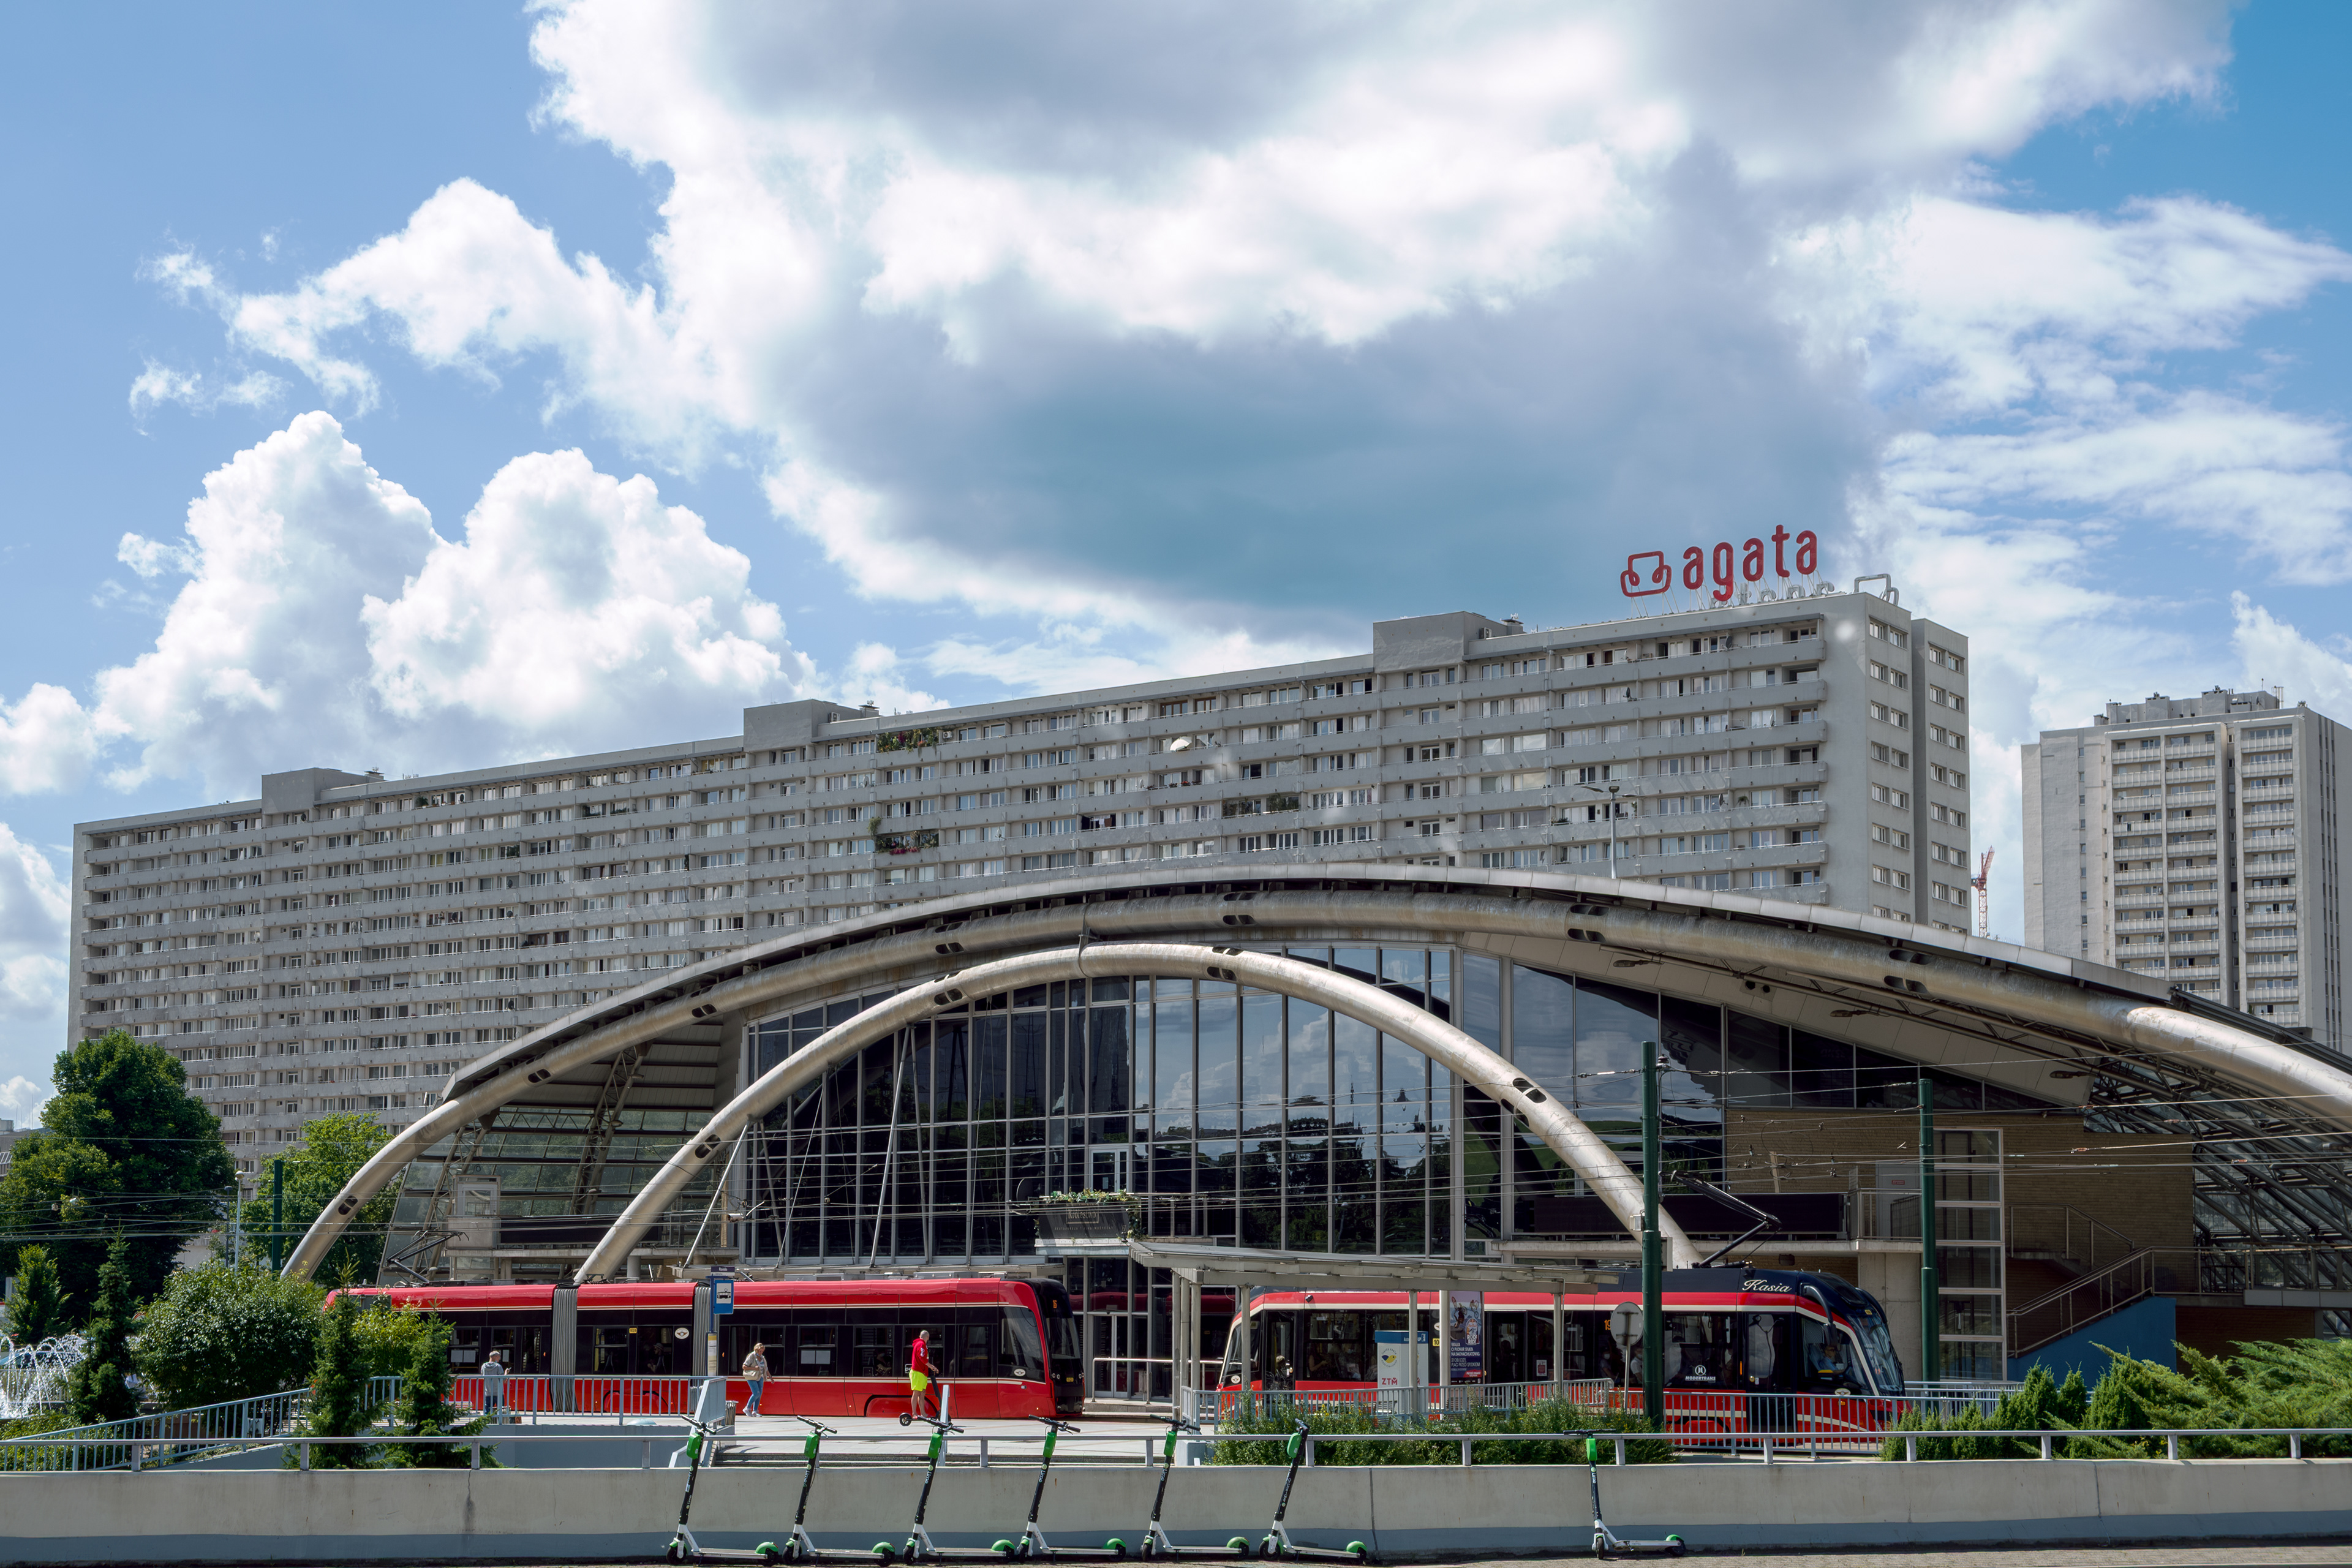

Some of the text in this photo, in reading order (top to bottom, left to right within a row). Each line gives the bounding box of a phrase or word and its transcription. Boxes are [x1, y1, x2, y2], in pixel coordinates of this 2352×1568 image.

[1683, 524, 1817, 601] agata
[1741, 1279, 1793, 1292] Kasia
[1381, 1377, 1398, 1385] ZTM
